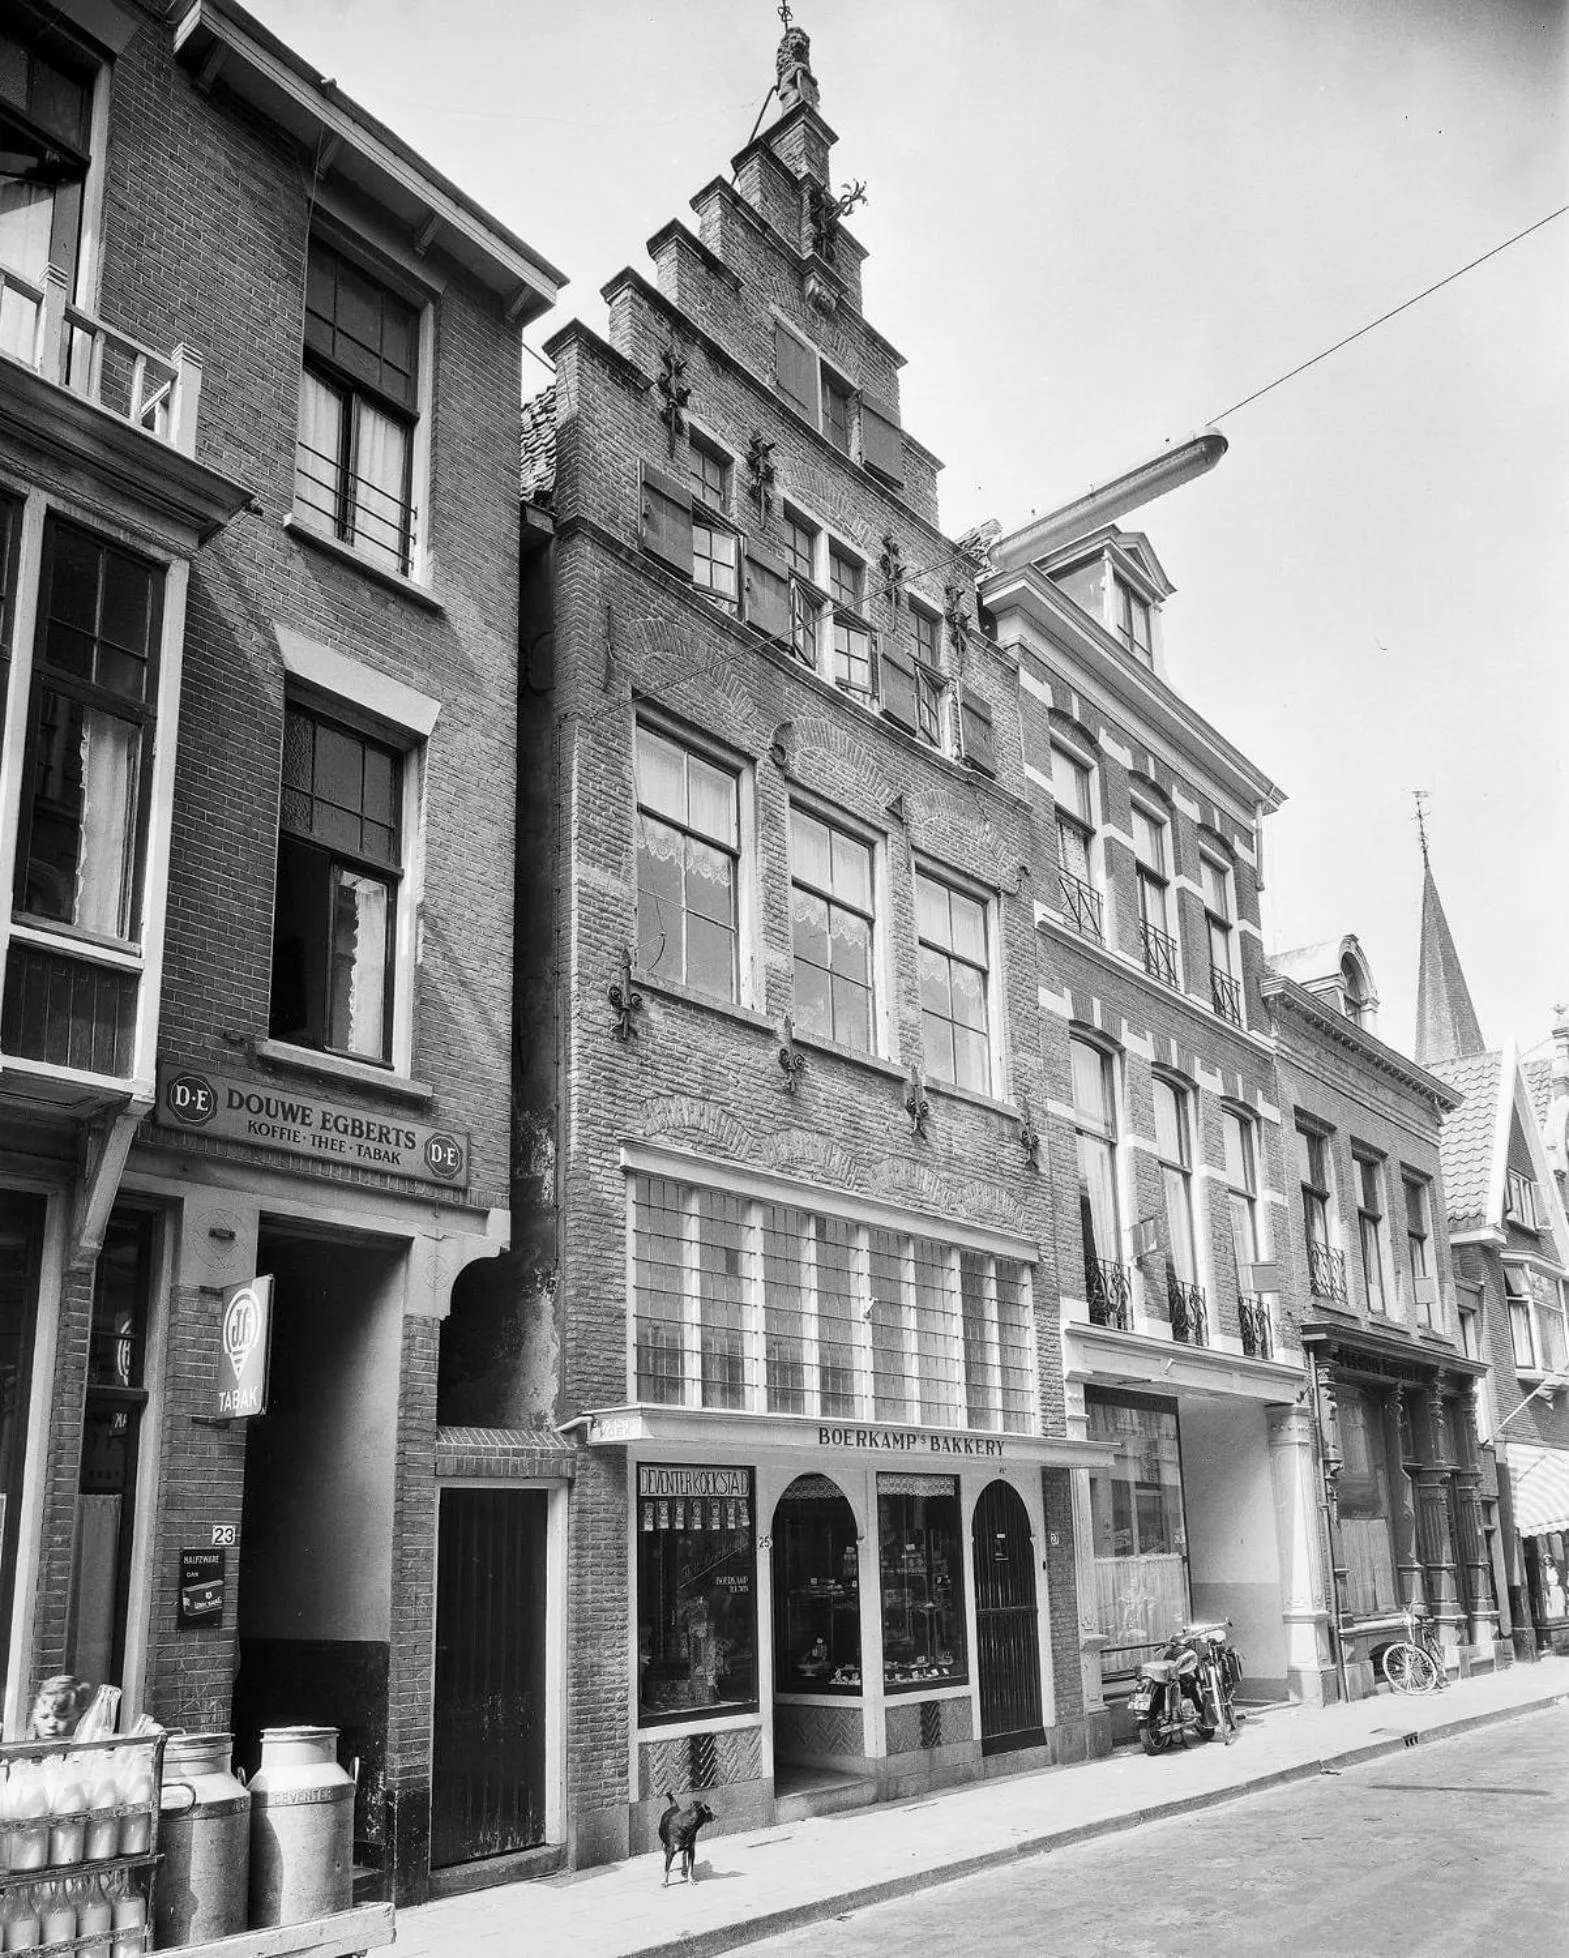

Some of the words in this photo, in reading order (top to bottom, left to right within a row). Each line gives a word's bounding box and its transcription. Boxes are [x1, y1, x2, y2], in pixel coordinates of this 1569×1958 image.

[226, 1088, 313, 1127] DOUWE
[320, 1111, 416, 1149] EGBERTS
[247, 1119, 300, 1143] KOFFIE
[310, 1134, 347, 1153] THEE
[356, 1144, 401, 1165] TABAK
[219, 1386, 258, 1413] TABAK
[930, 1435, 1005, 1456] BAKKERY
[215, 1528, 233, 1544] 23
[760, 1536, 770, 1548] 25
